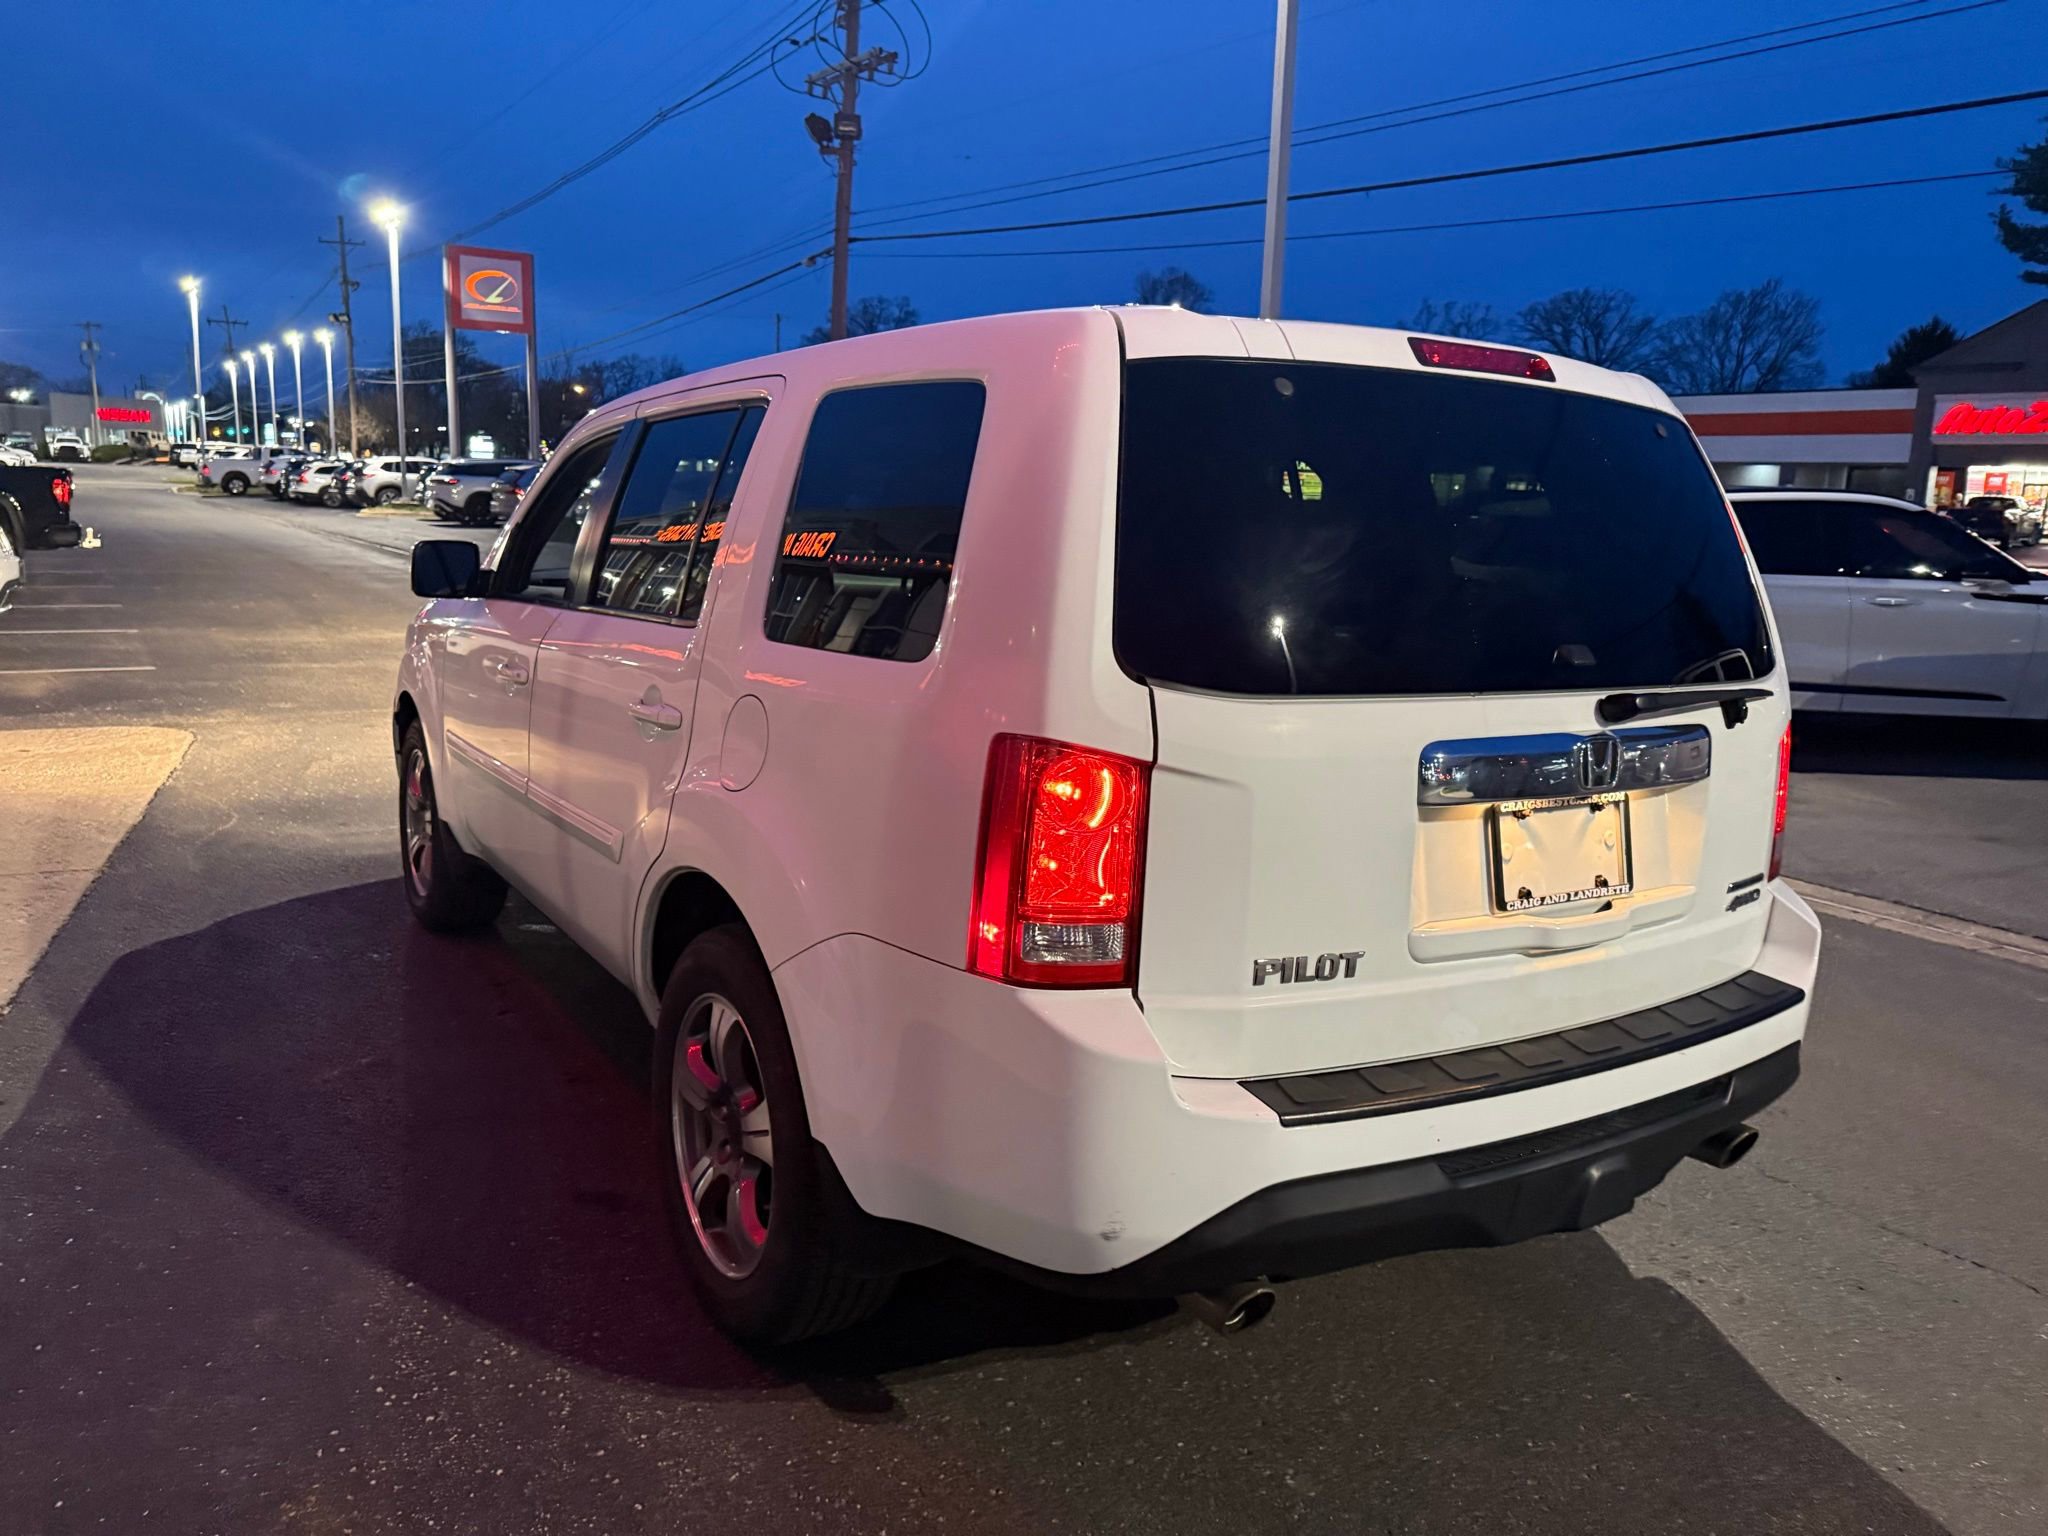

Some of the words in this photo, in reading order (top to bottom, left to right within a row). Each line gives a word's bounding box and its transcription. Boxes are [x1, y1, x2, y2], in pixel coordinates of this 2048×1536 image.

[96, 407, 151, 423] NISSAN
[1500, 791, 1626, 813] CRAIGSBESTCARS.COM
[1506, 896, 1542, 911] CRAIG
[1543, 892, 1568, 905] AND
[1570, 884, 1631, 900] LANDRETH
[1252, 951, 1366, 986] PILOT
